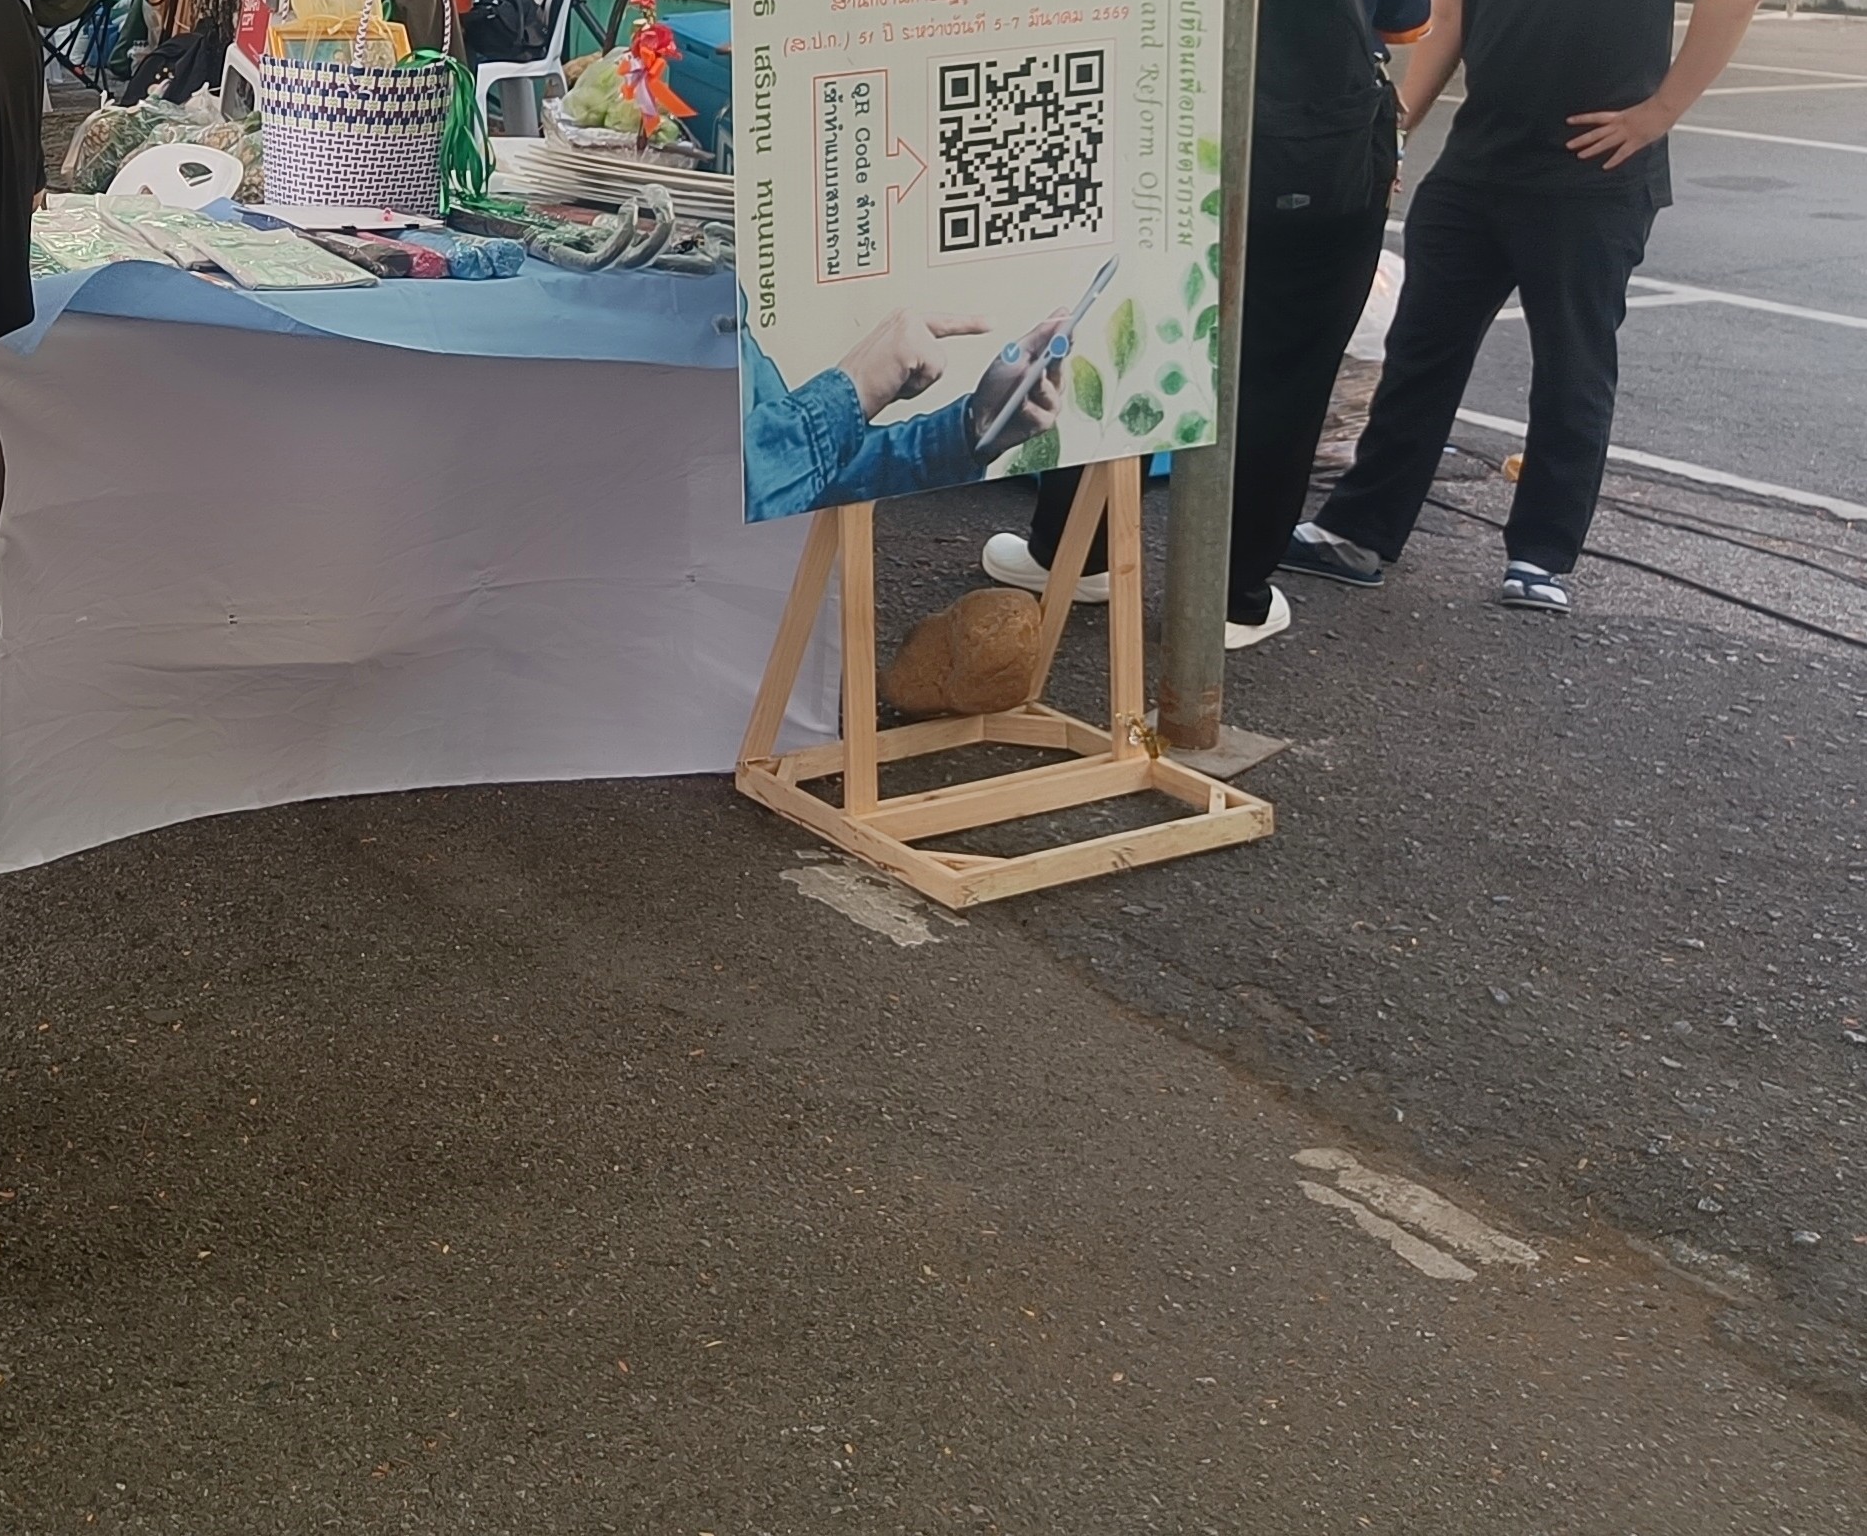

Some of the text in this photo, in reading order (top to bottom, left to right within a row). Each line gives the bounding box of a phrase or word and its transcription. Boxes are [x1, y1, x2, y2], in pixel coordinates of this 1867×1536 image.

[859, 31, 874, 45] 51
[882, 22, 895, 43] ปี
[994, 17, 1020, 31] 5-7
[1027, 7, 1083, 28] มีนาคม
[1092, 6, 1131, 21] 2569
[749, 45, 778, 155] เสริมทุน
[1133, 64, 1163, 157] Reform
[850, 81, 877, 267] QR Code สำหรับ
[1131, 171, 1163, 249] Office
[751, 178, 777, 329] หนุนเกษตร
